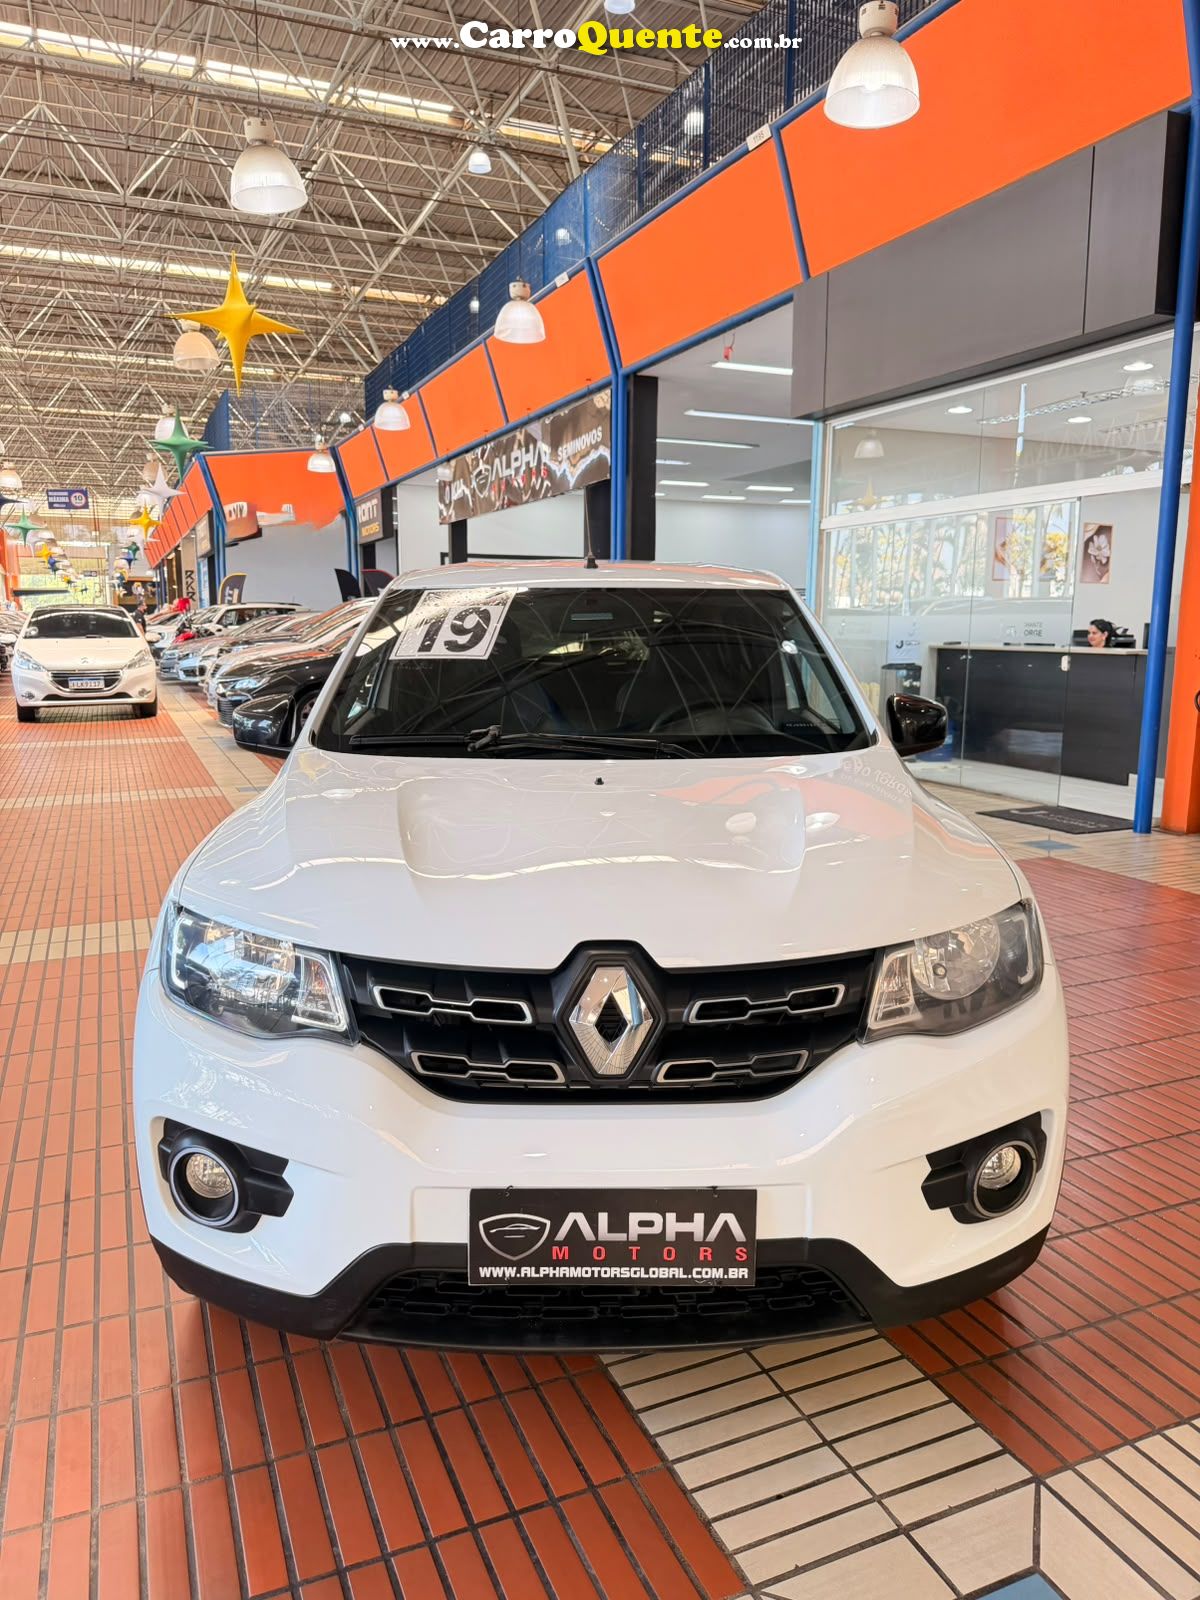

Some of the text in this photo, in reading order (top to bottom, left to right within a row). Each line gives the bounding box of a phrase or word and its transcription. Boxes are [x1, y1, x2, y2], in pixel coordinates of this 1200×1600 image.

[557, 426, 602, 461] SEMINOVOS
[491, 441, 551, 481] ALPHA
[415, 606, 491, 653] 19
[554, 1211, 747, 1242] ALPHA
[552, 1246, 748, 1261] MOTORS
[479, 1266, 749, 1279] WWW.ALPHAMOTORSGLOBAL.COM.BR
